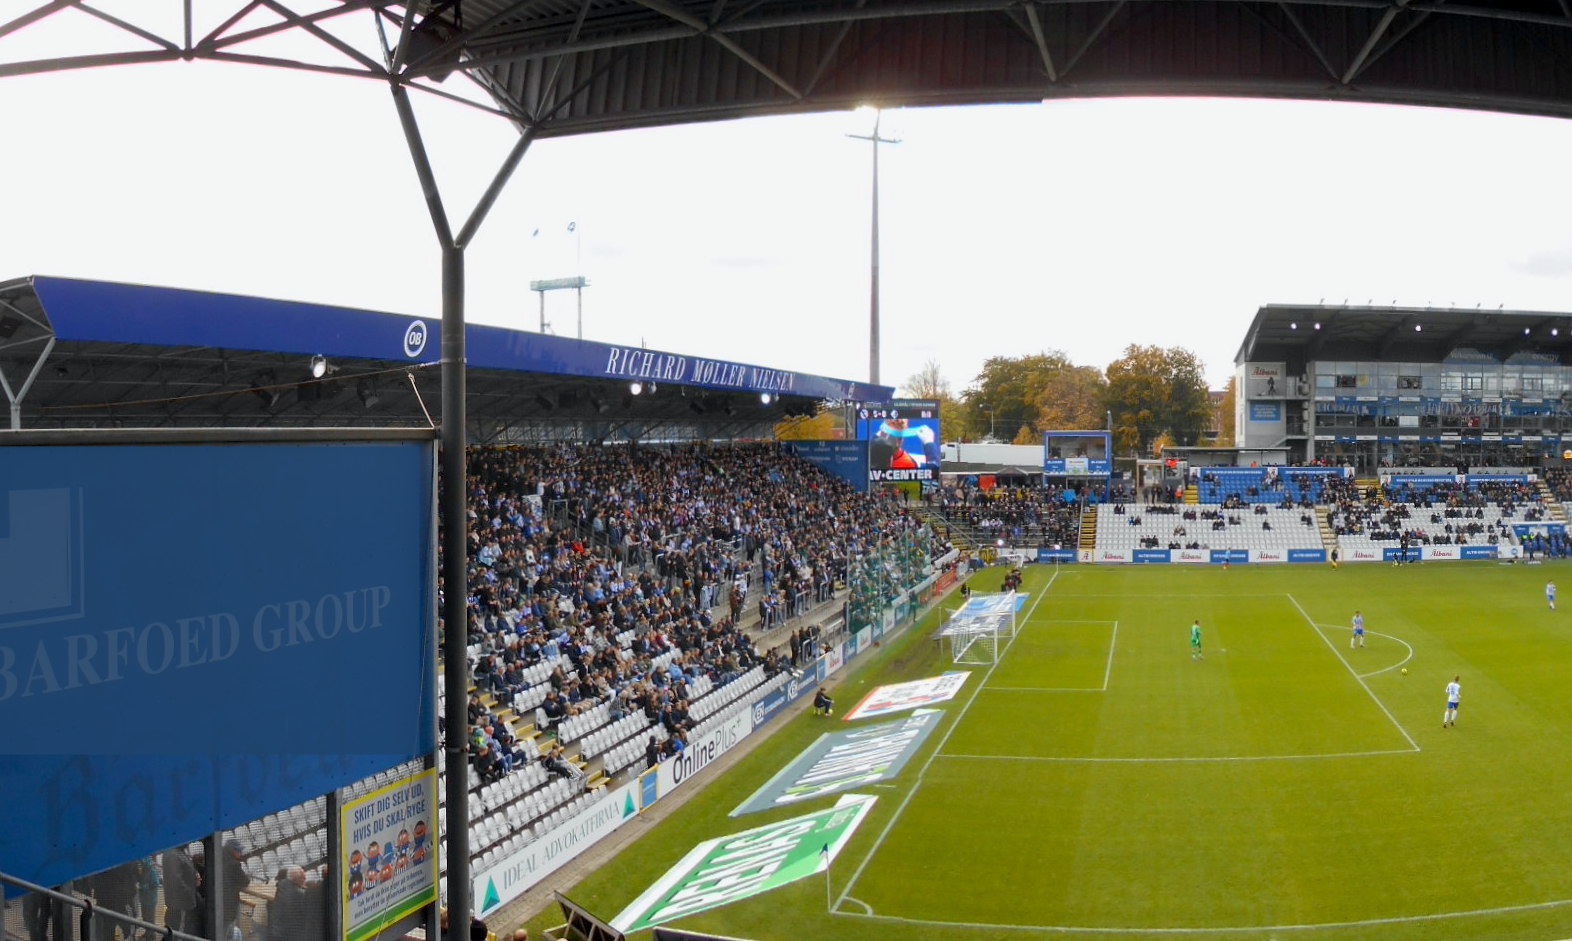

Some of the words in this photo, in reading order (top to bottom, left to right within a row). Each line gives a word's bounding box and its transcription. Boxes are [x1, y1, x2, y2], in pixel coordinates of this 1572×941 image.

[409, 331, 422, 345] OB
[605, 347, 687, 381] RICHARD
[691, 360, 746, 387] MØLLER
[749, 367, 797, 392] NIELSEN
[1251, 366, 1278, 376] Albani
[1102, 551, 1125, 560] Albani
[1257, 551, 1280, 560] Albani
[1352, 551, 1375, 560] Albani
[1431, 549, 1453, 557] Albani
[252, 585, 391, 652] GROUP
[354, 803, 374, 824] SKIFT
[377, 797, 390, 813] DIG
[392, 789, 410, 807] SELV
[353, 827, 371, 844] HVIS
[373, 820, 384, 834] DU
[386, 811, 405, 828] SKAL
[406, 801, 426, 818] RYGE
[503, 854, 538, 890] IDEAL
[544, 801, 620, 861] ADVOKATFIRMA
